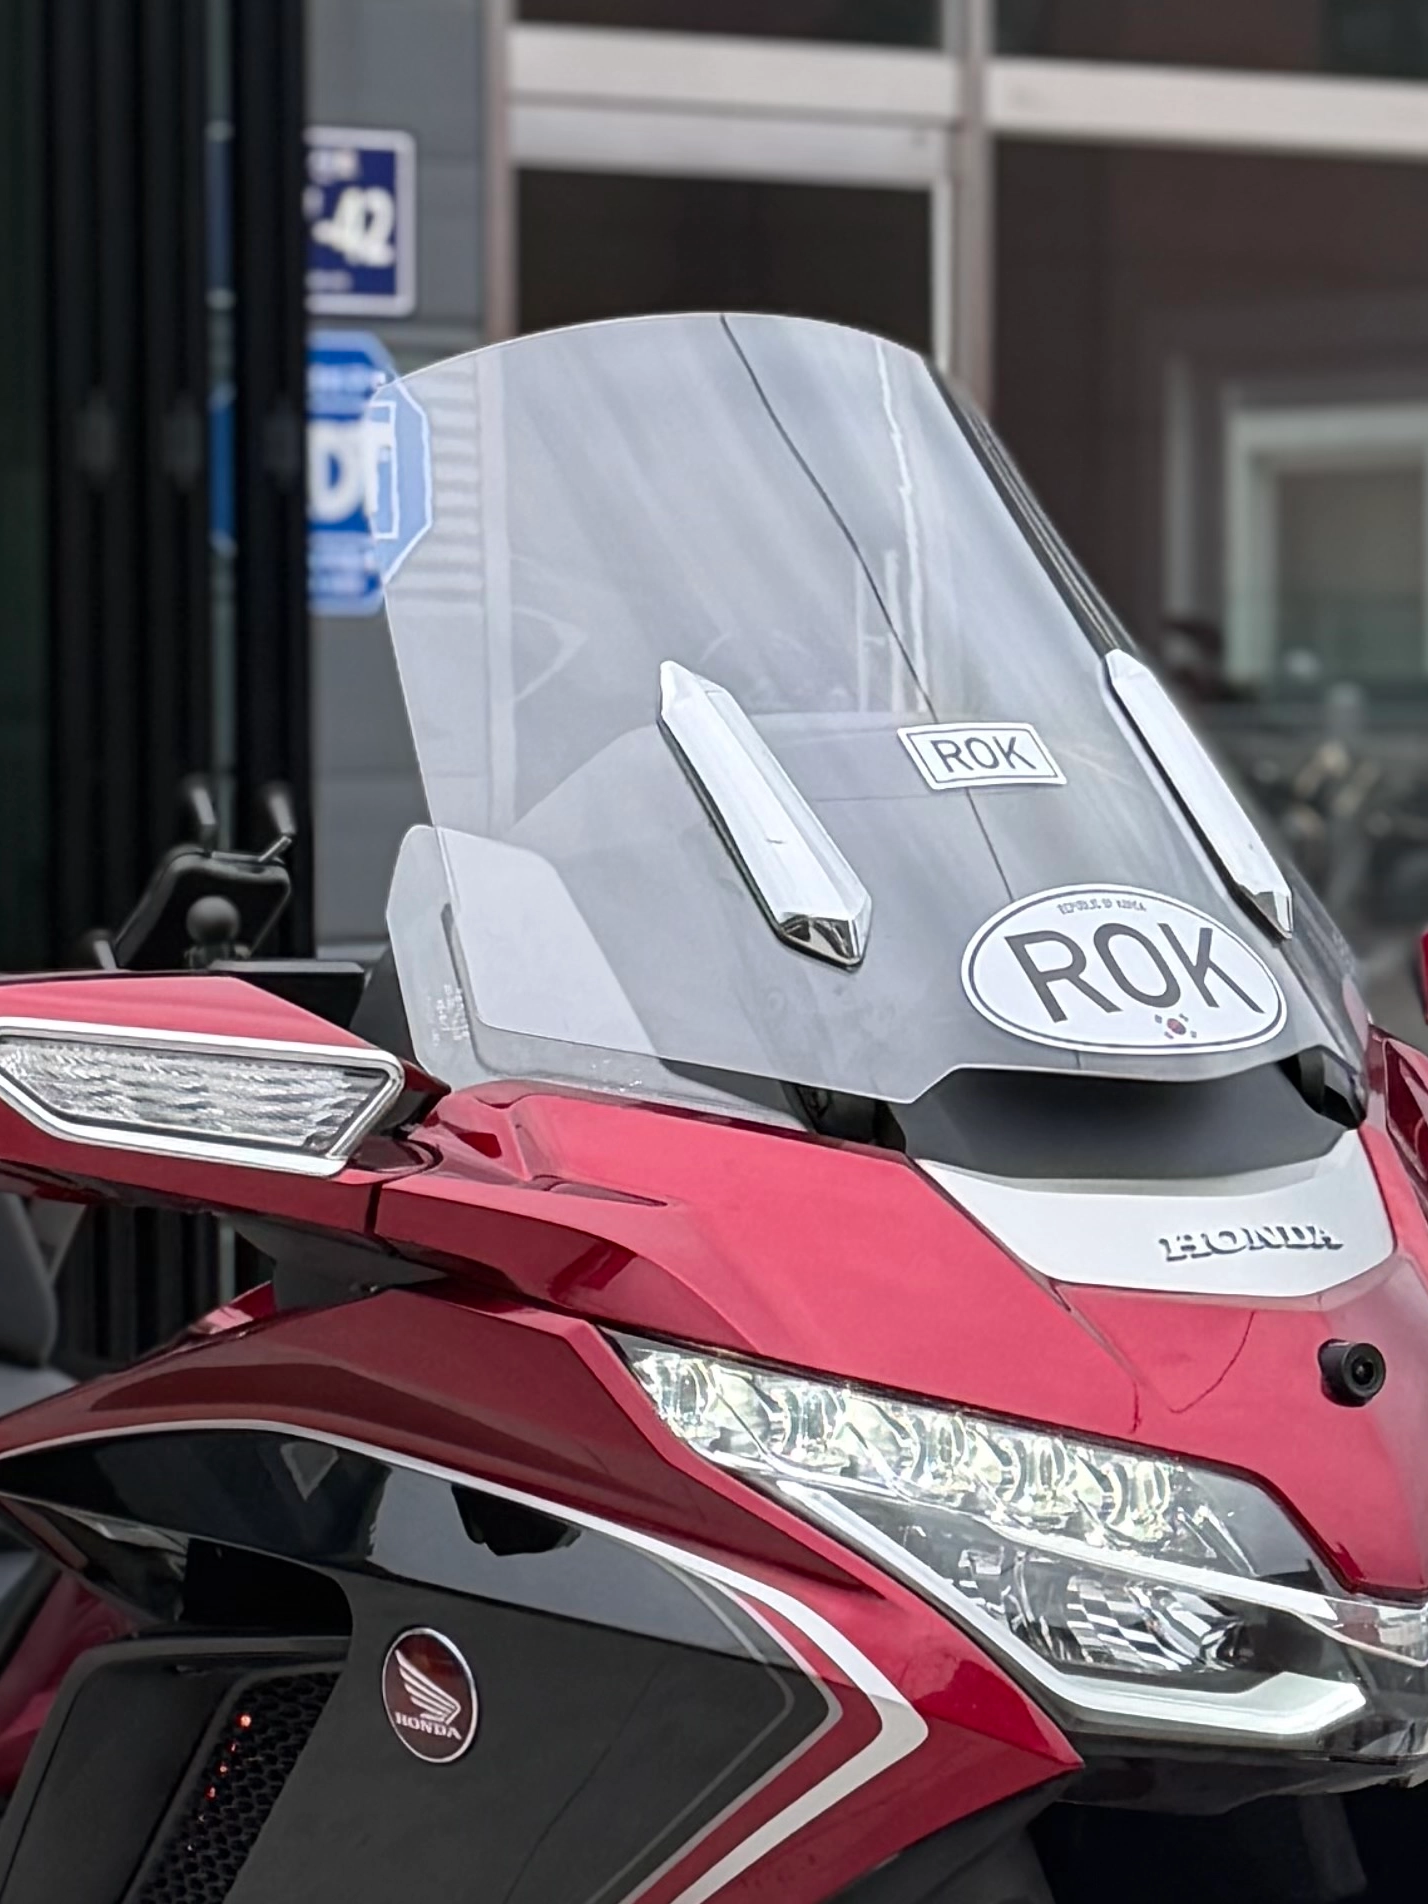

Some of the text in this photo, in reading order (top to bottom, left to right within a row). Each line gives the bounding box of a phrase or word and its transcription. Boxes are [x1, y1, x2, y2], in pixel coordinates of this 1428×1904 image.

[305, 186, 394, 266] -42
[930, 736, 1037, 773] ROK
[1004, 922, 1265, 1023] ROK
[1158, 1223, 1343, 1262] HONDA
[395, 1712, 462, 1740] HONDA
